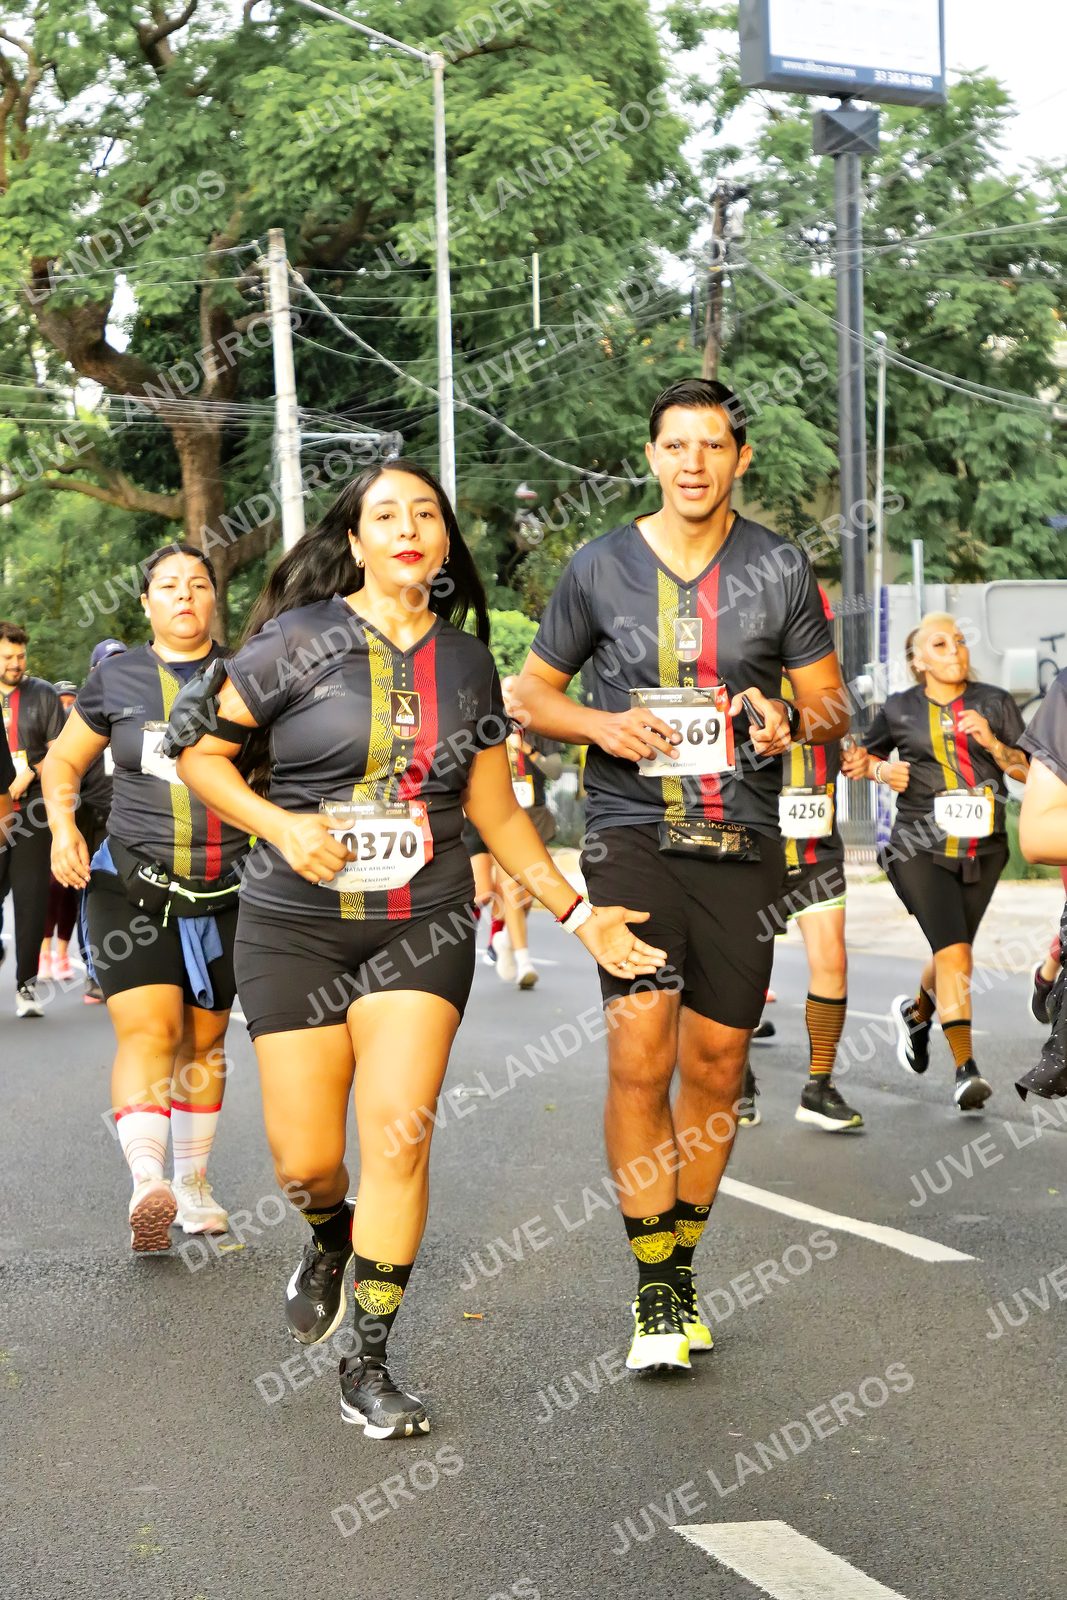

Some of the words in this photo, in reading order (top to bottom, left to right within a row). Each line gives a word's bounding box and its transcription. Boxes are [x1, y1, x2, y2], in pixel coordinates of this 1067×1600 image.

[651, 718, 720, 746] 369
[788, 802, 826, 819] 4256
[944, 803, 984, 819] 4270
[333, 830, 418, 861] 0370
